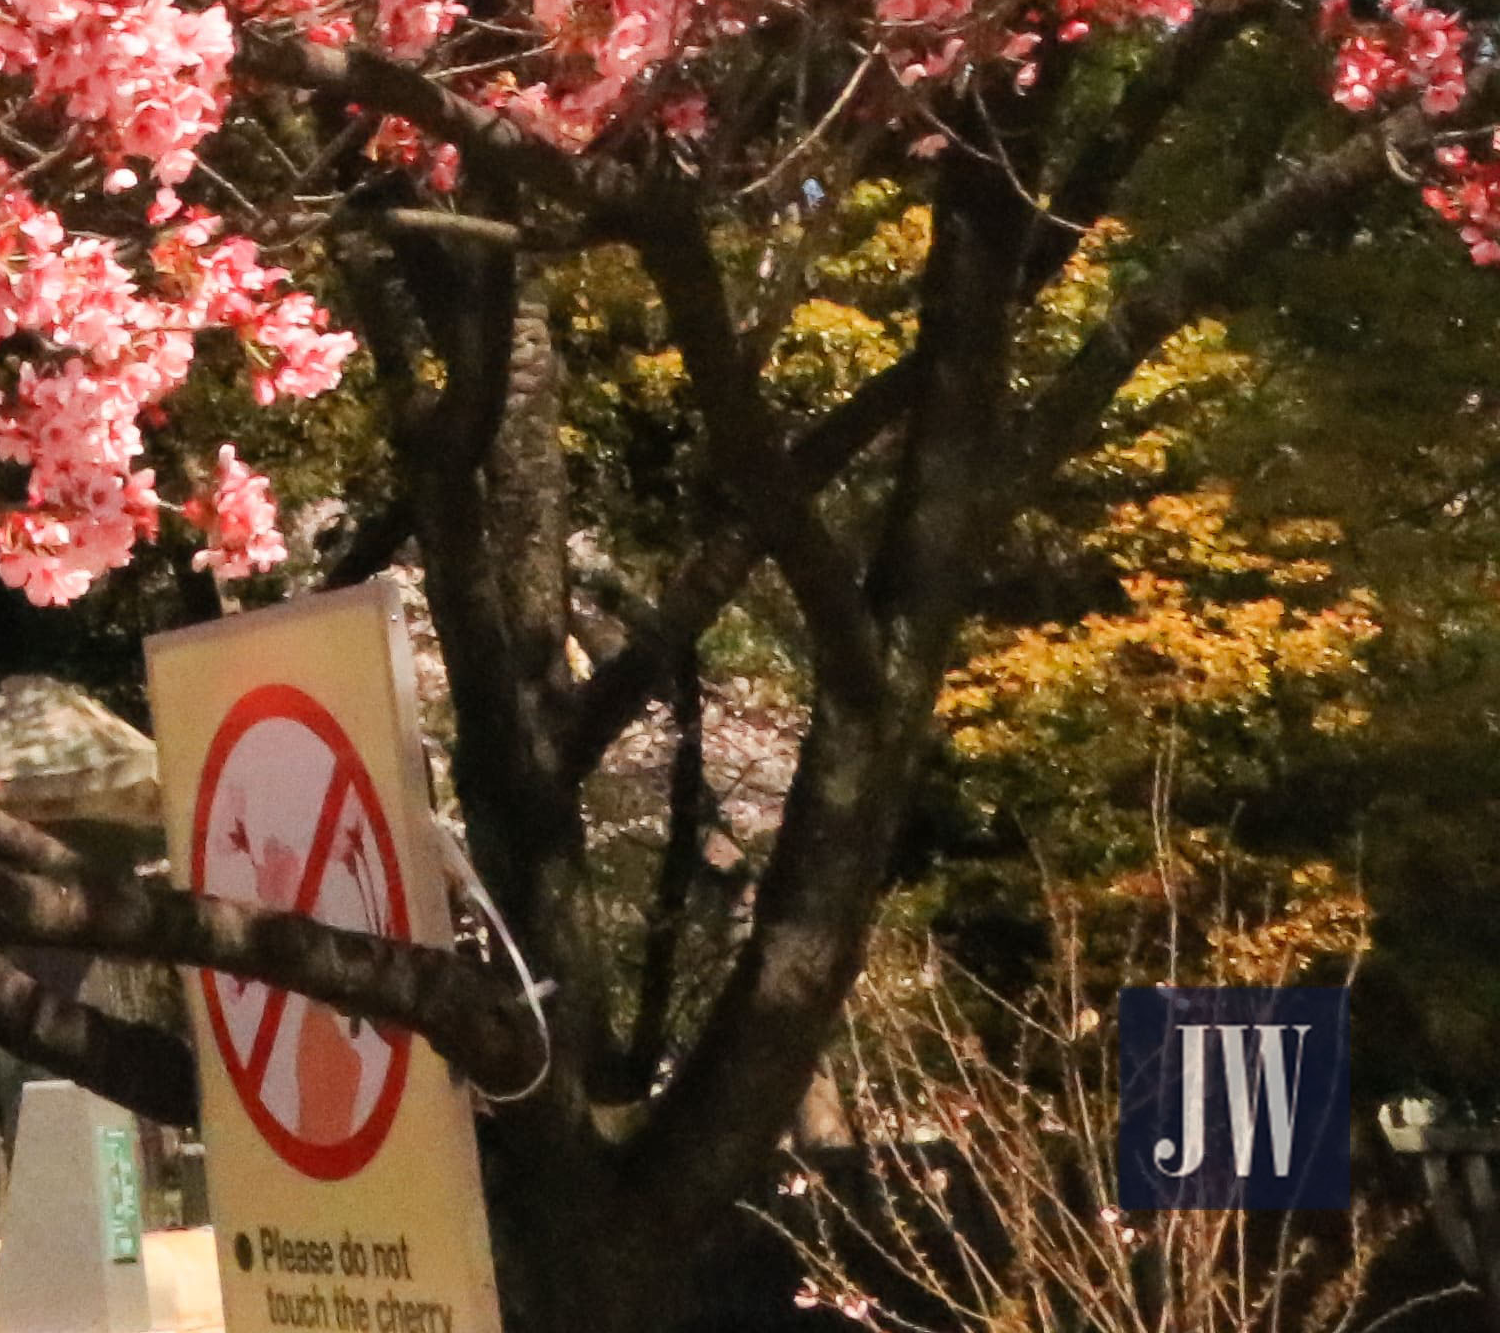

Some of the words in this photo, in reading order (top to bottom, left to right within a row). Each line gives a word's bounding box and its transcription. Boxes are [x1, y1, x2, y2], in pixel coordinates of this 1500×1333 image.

[258, 1225, 334, 1275] Please
[338, 1229, 367, 1277] do
[371, 1232, 414, 1282] not
[265, 1284, 329, 1328] touch
[332, 1284, 370, 1333] the
[374, 1287, 453, 1333] cherry
